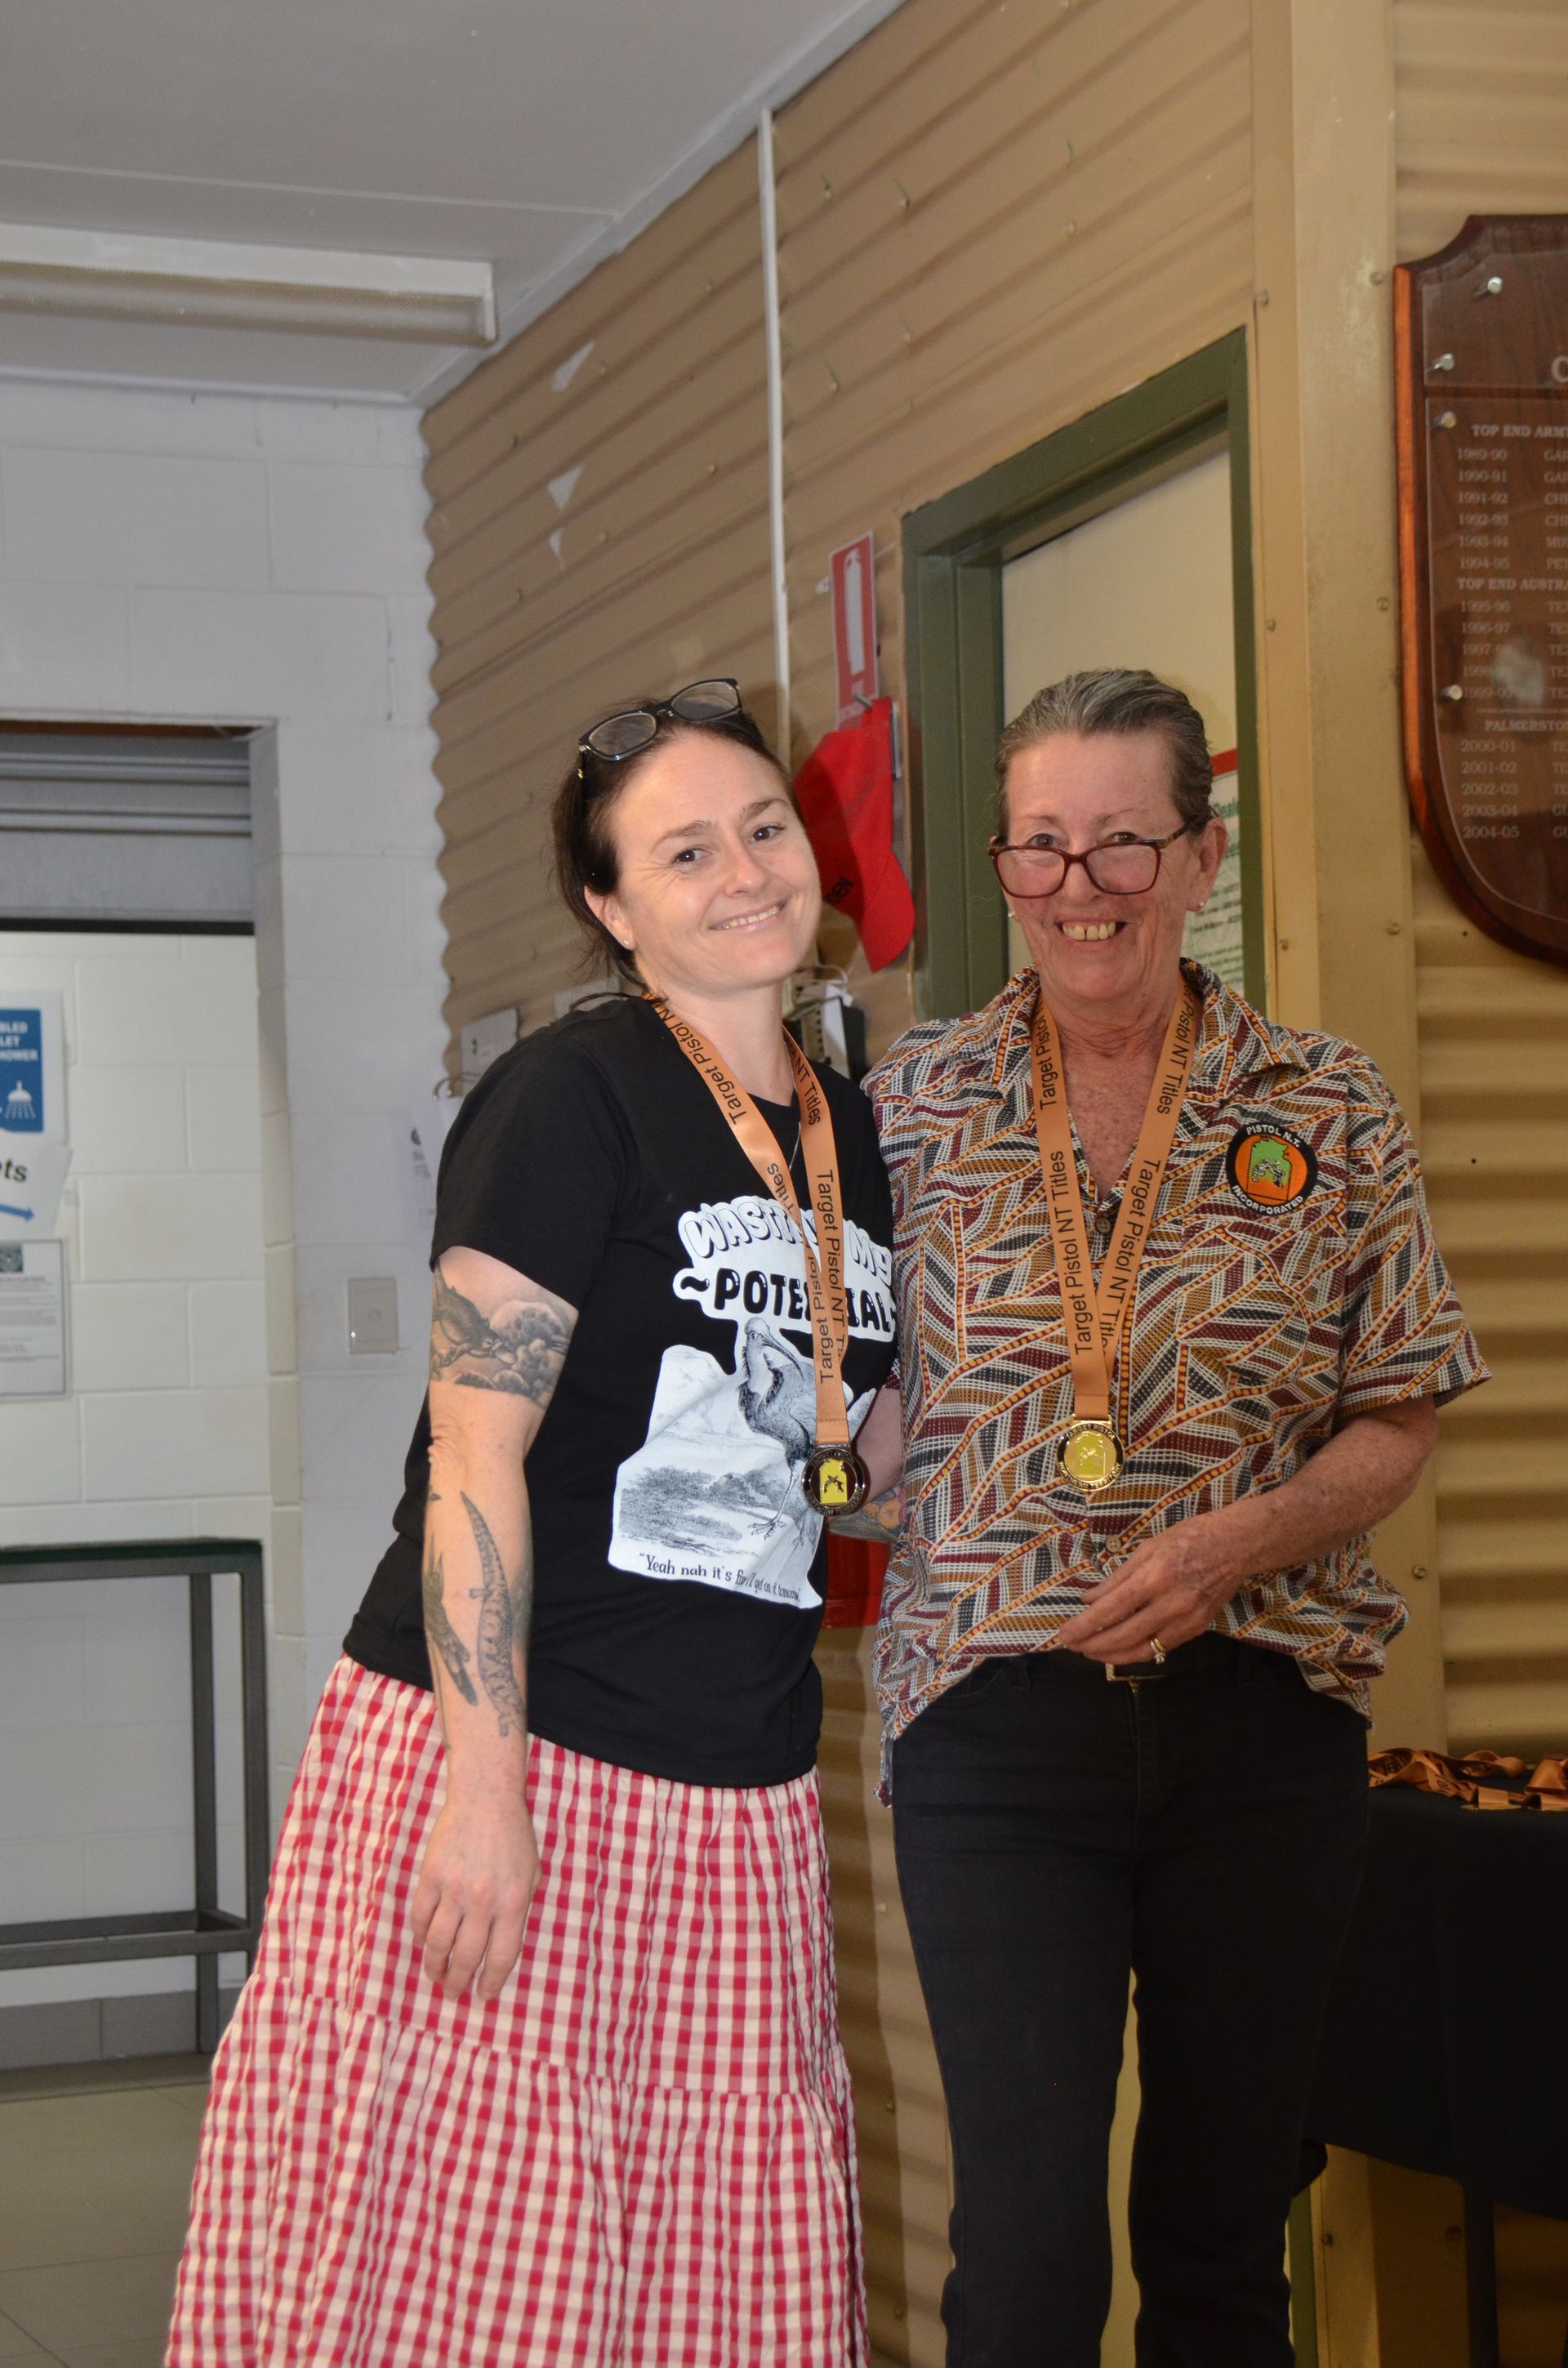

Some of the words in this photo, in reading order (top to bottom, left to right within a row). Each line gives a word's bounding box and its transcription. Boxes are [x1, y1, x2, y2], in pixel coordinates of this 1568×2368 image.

[1472, 424, 1500, 437] TOP
[1503, 424, 1531, 437] END
[1457, 578, 1485, 590] TOP
[1489, 578, 1517, 591] END
[1461, 739, 1516, 752] 2000-01
[1461, 760, 1517, 774] 2001-02
[1462, 783, 1518, 796] 2002-03
[1463, 804, 1519, 818] 2003-04
[1463, 825, 1520, 839] 2004-05
[1175, 999, 1194, 1044] Pistol
[669, 1023, 712, 1064] Pistol
[1170, 1043, 1190, 1070] NT
[705, 1064, 746, 1126] Target
[1037, 1056, 1058, 1110] Target
[1156, 1074, 1183, 1115] Titles
[804, 1081, 822, 1126] Titles
[1246, 1124, 1281, 1135] PISTOL
[1282, 1130, 1301, 1148] N.T.
[1049, 1150, 1069, 1202] Titles
[1129, 1158, 1161, 1217] Target
[817, 1169, 840, 1232] Target
[1232, 1184, 1303, 1215] INCORPORATED
[1054, 1207, 1074, 1233] NT
[826, 1238, 840, 1292] Pistol
[1060, 1238, 1083, 1289] Pistol
[1116, 1222, 1144, 1274] Pistol
[1106, 1275, 1129, 1304] NT
[831, 1295, 844, 1328] NT
[1068, 1292, 1094, 1355] Target
[816, 1317, 835, 1384] Target
[680, 1564, 707, 1577] nah
[754, 1578, 764, 1594] get
